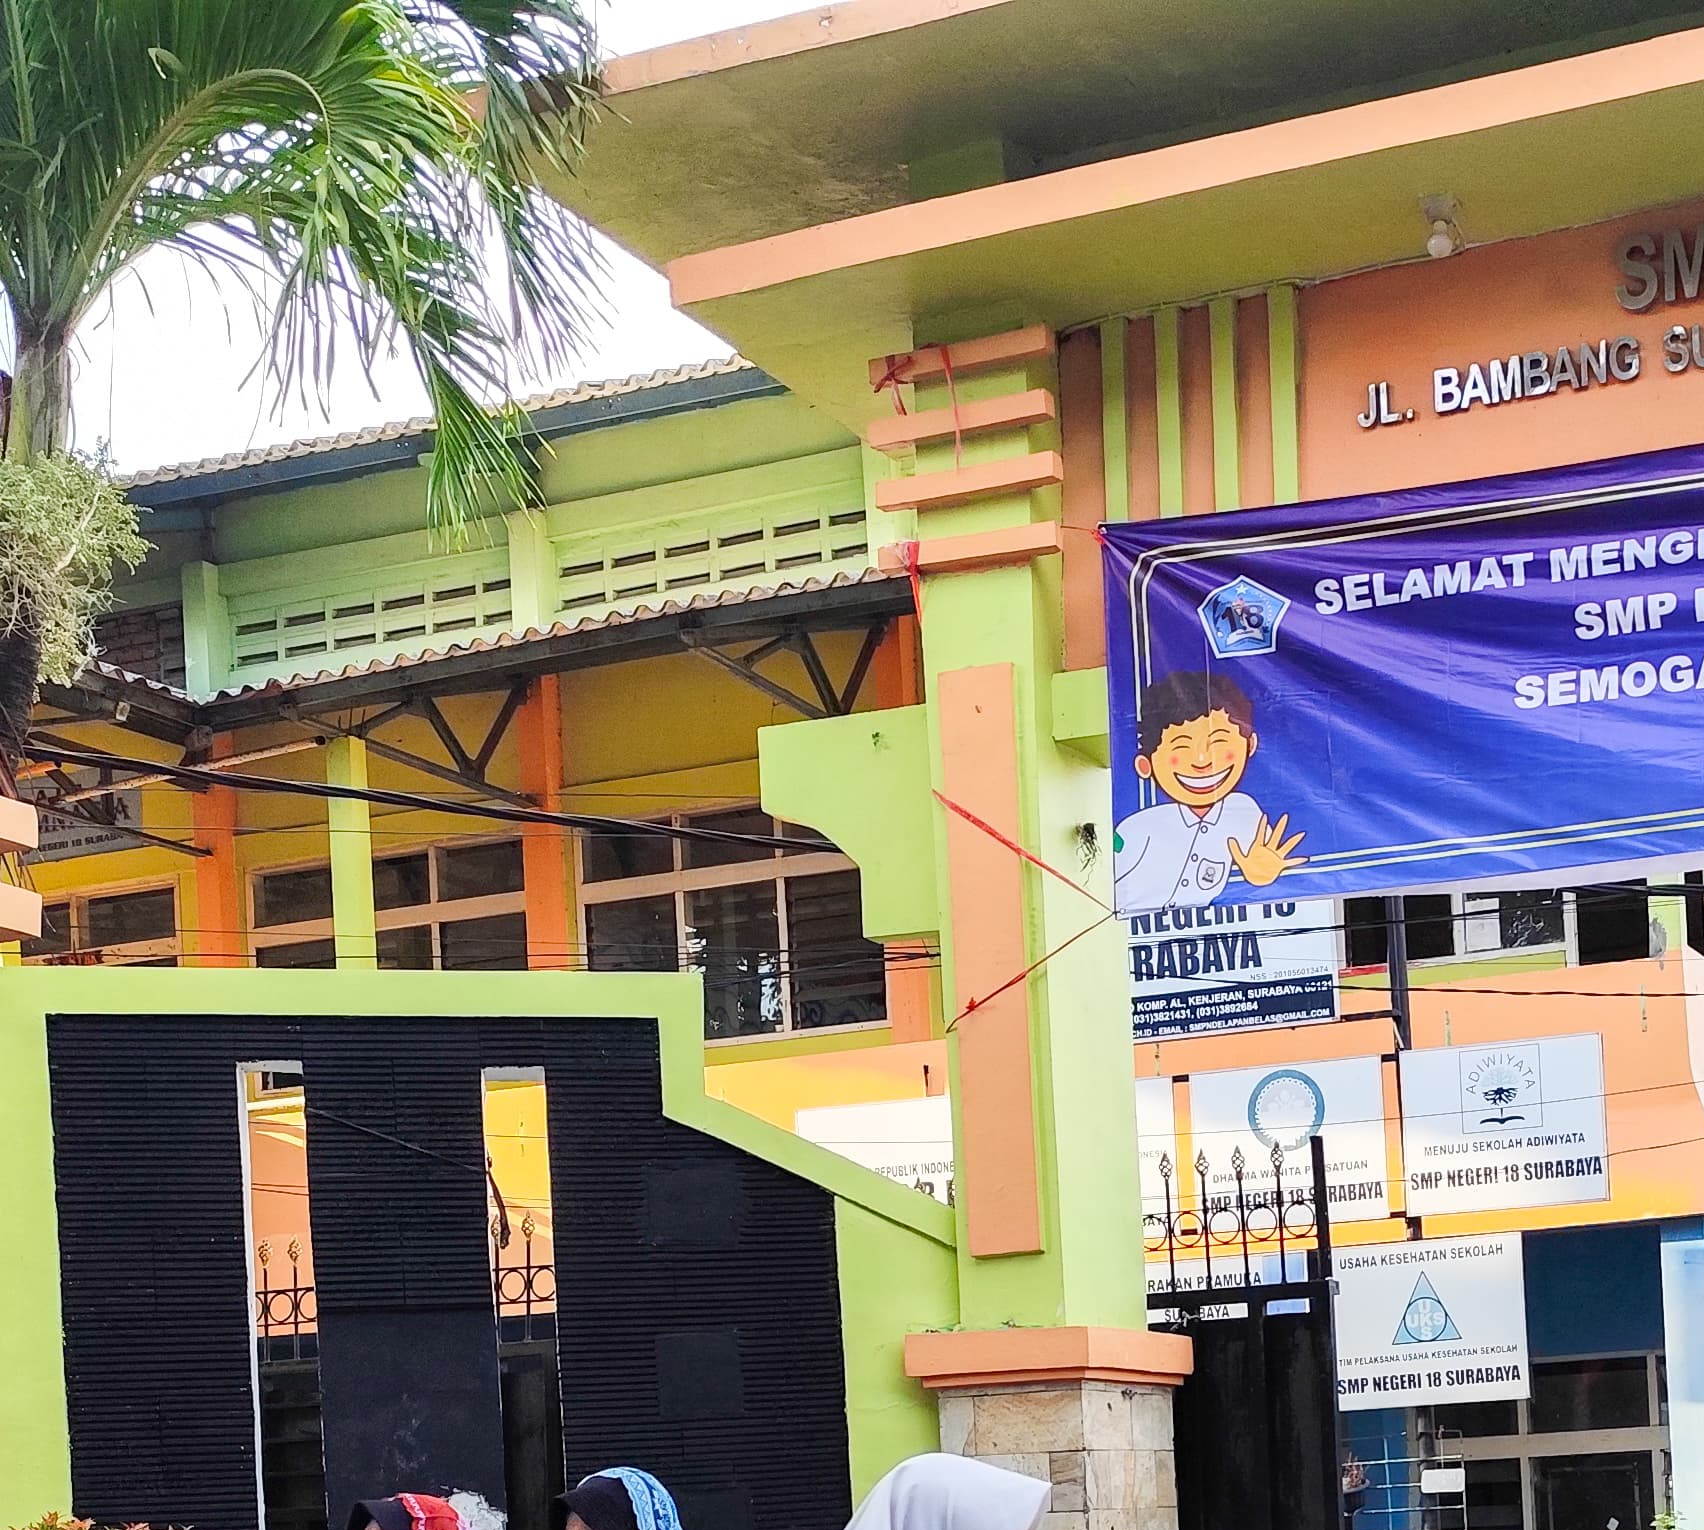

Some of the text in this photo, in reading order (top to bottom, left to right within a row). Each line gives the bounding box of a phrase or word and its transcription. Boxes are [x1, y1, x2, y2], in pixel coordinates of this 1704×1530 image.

[1358, 381, 1414, 428] JL.
[1435, 339, 1640, 413] BAMBANG
[1314, 553, 1534, 615] SELAMAT
[1575, 593, 1676, 641] SMP
[1136, 1000, 1168, 1012] KOMP.
[1188, 991, 1246, 1006] KENJERAN,
[1247, 985, 1303, 999] SURABAYA
[1466, 1053, 1535, 1095] ADIWIYATA
[1424, 1132, 1586, 1156] MENUJU SEKOLAH ADIWIYATA
[1213, 1171, 1257, 1184] DHAMA
[1305, 1160, 1368, 1176] PSATUAN
[1411, 1156, 1603, 1190] SMP NEGERI 18 SURABAYA
[1289, 1188, 1304, 1203] 18
[1309, 1181, 1383, 1205] SRABAYA
[1339, 1243, 1503, 1270] USAHA KESEHATAN SEKOLAH
[1164, 1306, 1230, 1321] SUBAYA
[1339, 1344, 1518, 1367] TIM PELAKSANA USAHA KESEHATAN SEKOLAH
[1337, 1365, 1521, 1395] SMP NEGERI 18 SURABAYA
